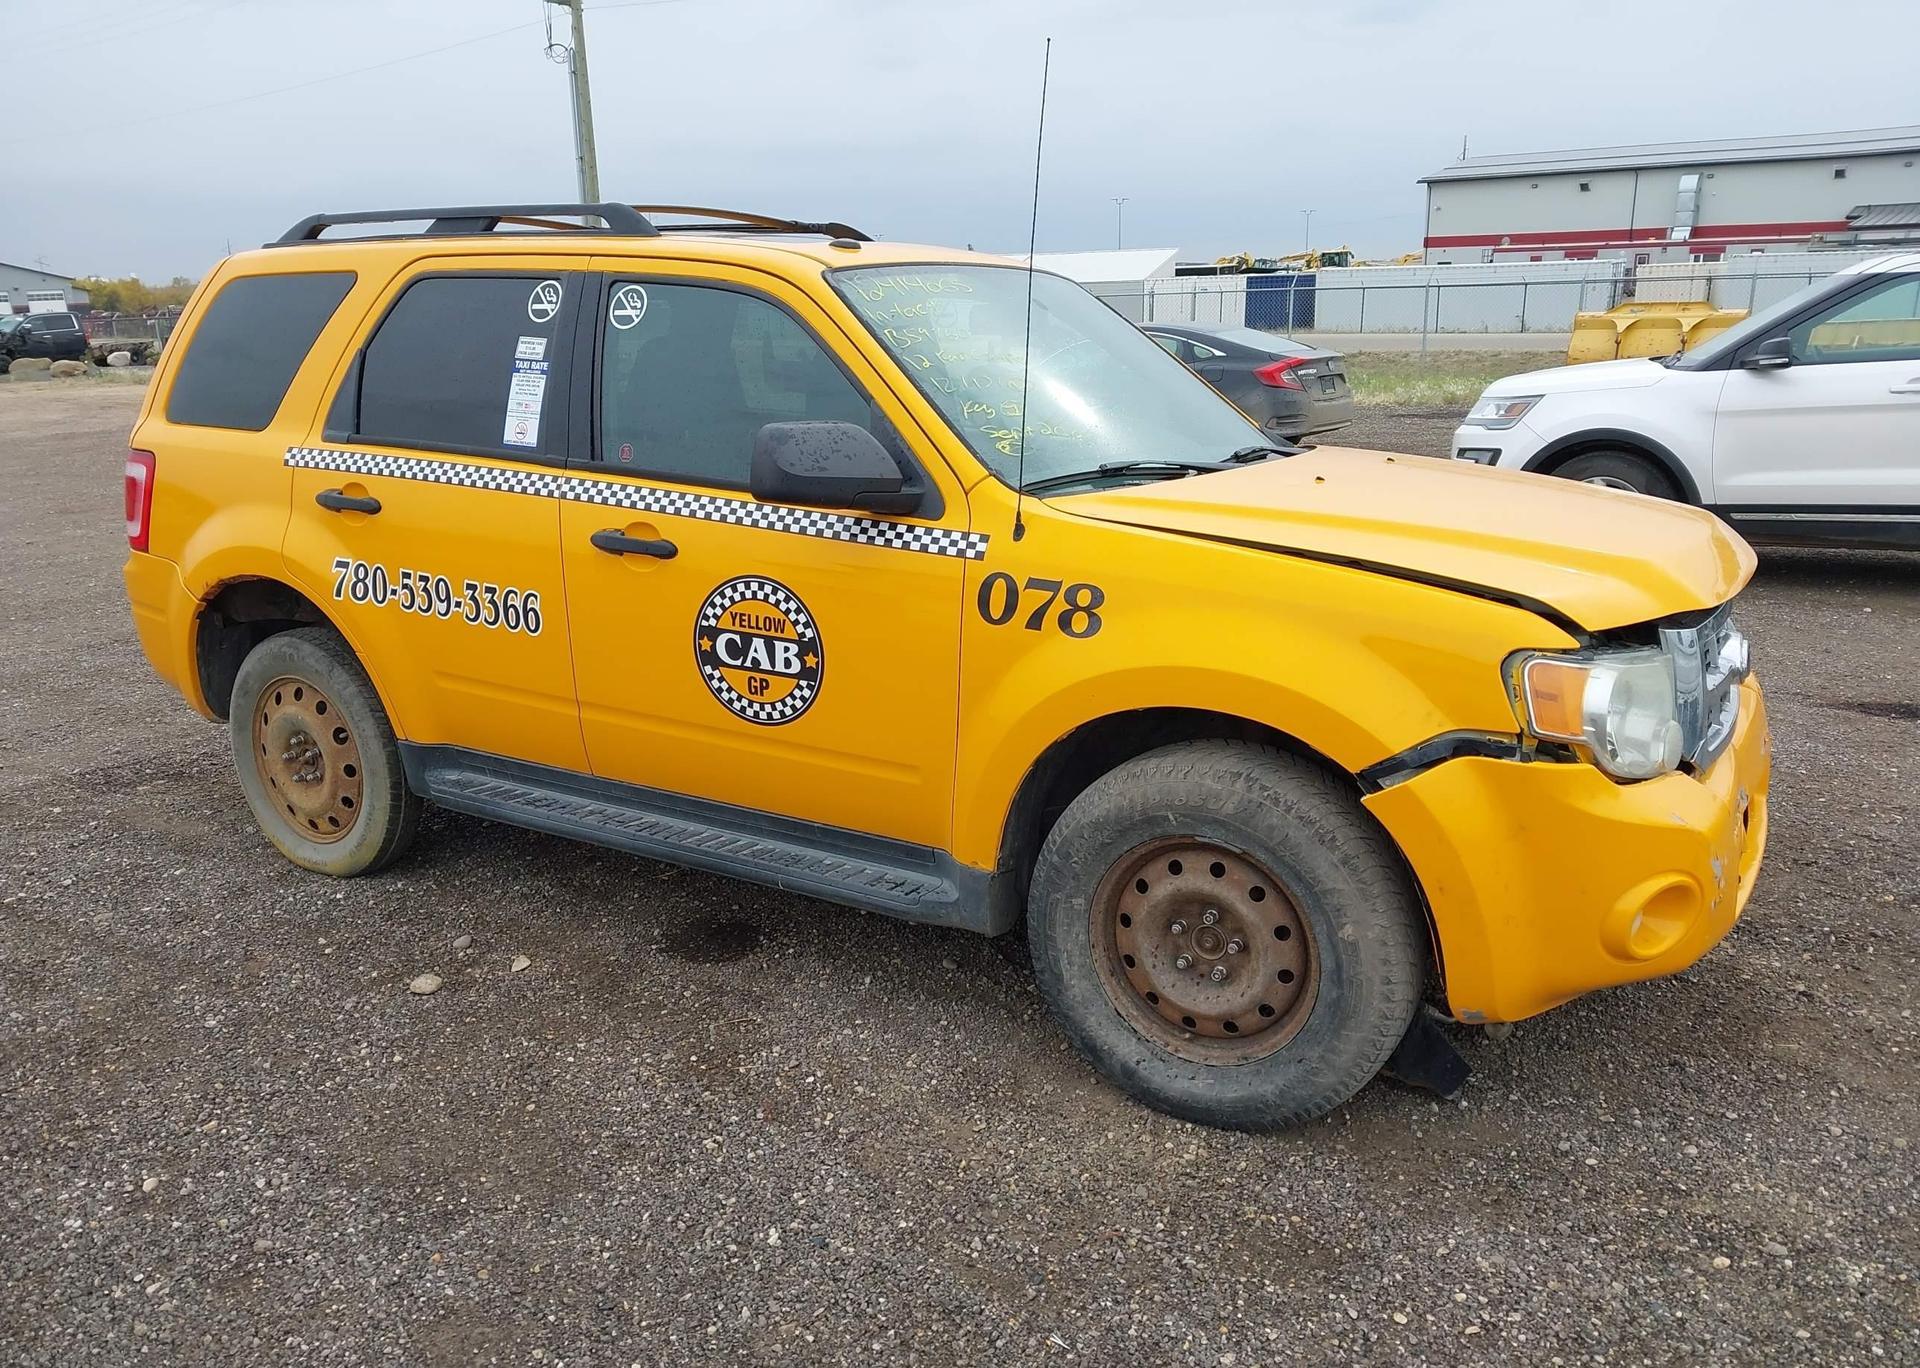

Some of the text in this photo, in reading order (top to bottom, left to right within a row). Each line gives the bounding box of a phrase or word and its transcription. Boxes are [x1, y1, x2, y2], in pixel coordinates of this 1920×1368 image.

[515, 360, 549, 370] TAXI RATE
[332, 557, 543, 636] 780-539-3366
[977, 572, 1105, 639] 078
[729, 611, 787, 634] YELLOW
[715, 632, 802, 675] CAB
[747, 676, 770, 697] GP
